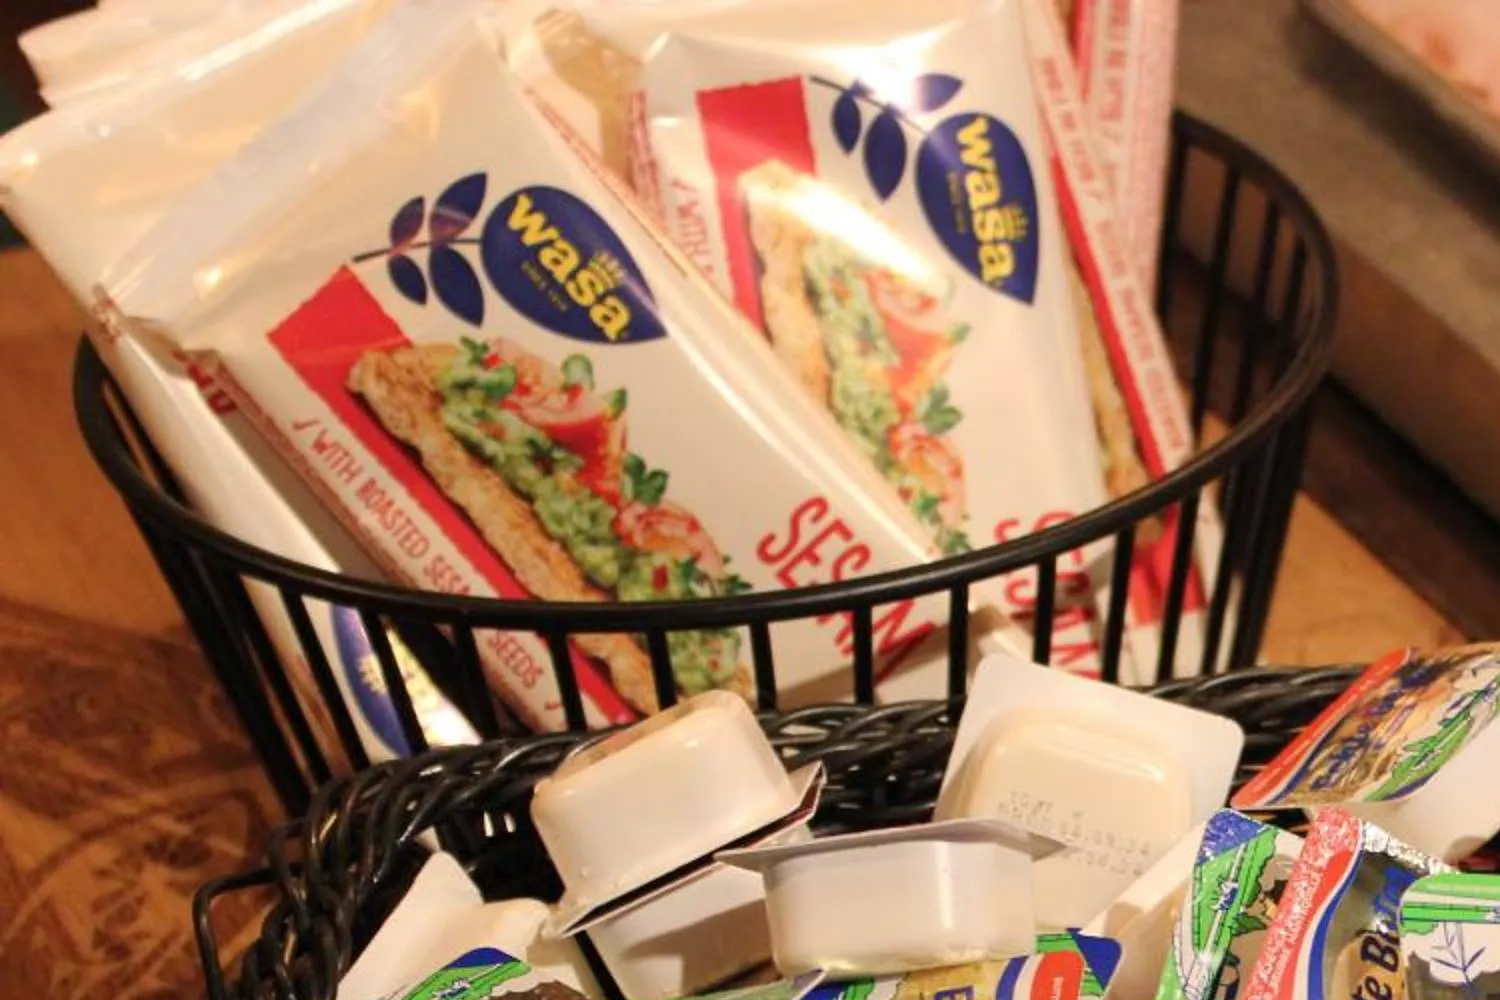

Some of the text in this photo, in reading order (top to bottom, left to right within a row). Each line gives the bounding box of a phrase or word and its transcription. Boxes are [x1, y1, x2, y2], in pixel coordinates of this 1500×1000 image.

[506, 192, 632, 342] wasa
[957, 115, 1015, 284] wasa
[310, 428, 364, 485] WITH
[354, 476, 431, 560] ROASTED
